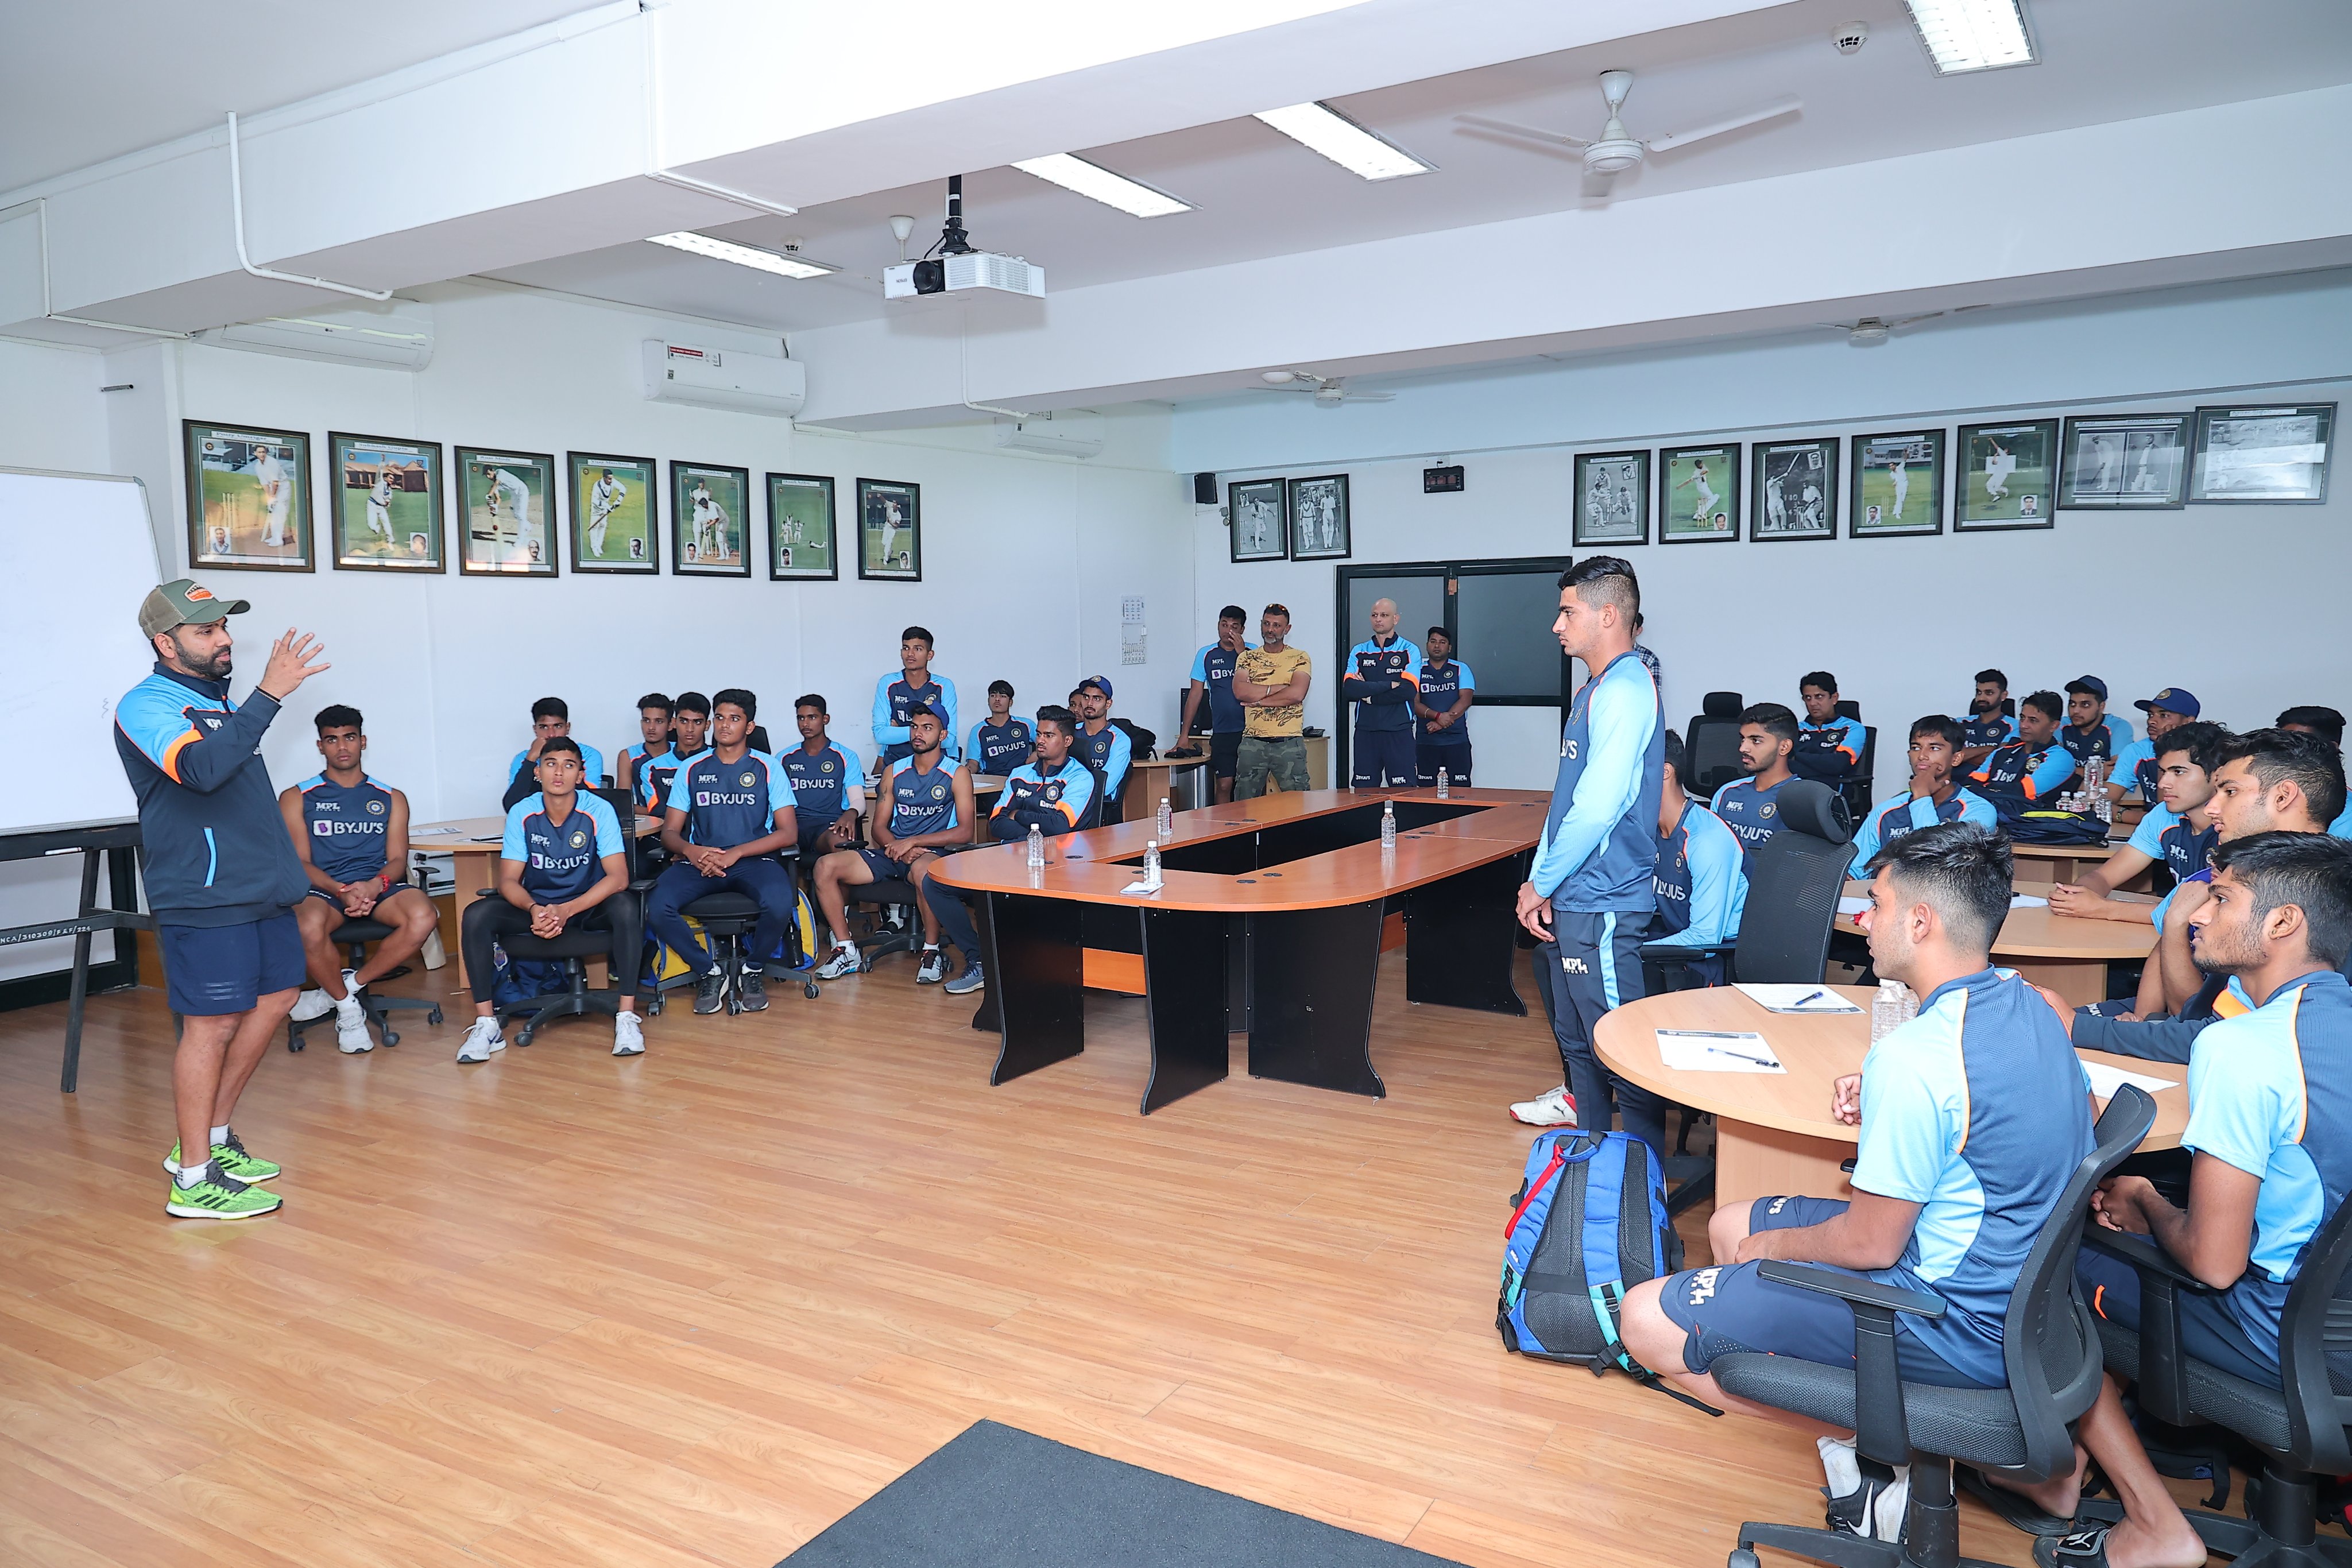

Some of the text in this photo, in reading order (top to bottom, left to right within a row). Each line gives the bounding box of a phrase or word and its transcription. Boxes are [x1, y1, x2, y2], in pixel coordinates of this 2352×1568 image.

[1430, 682, 1456, 692] BYJU'S
[895, 695, 909, 703] MPL
[999, 741, 1026, 753] BYJU'S
[799, 779, 835, 789] BYJU'S
[711, 793, 756, 805] BYJU'S
[1726, 800, 1744, 810] MPL
[910, 804, 944, 816] BYJU'S
[334, 822, 384, 834] BYJU'S
[531, 834, 551, 845] MPL
[544, 853, 590, 869] BYJU'S
[1561, 957, 1588, 970] MPL
